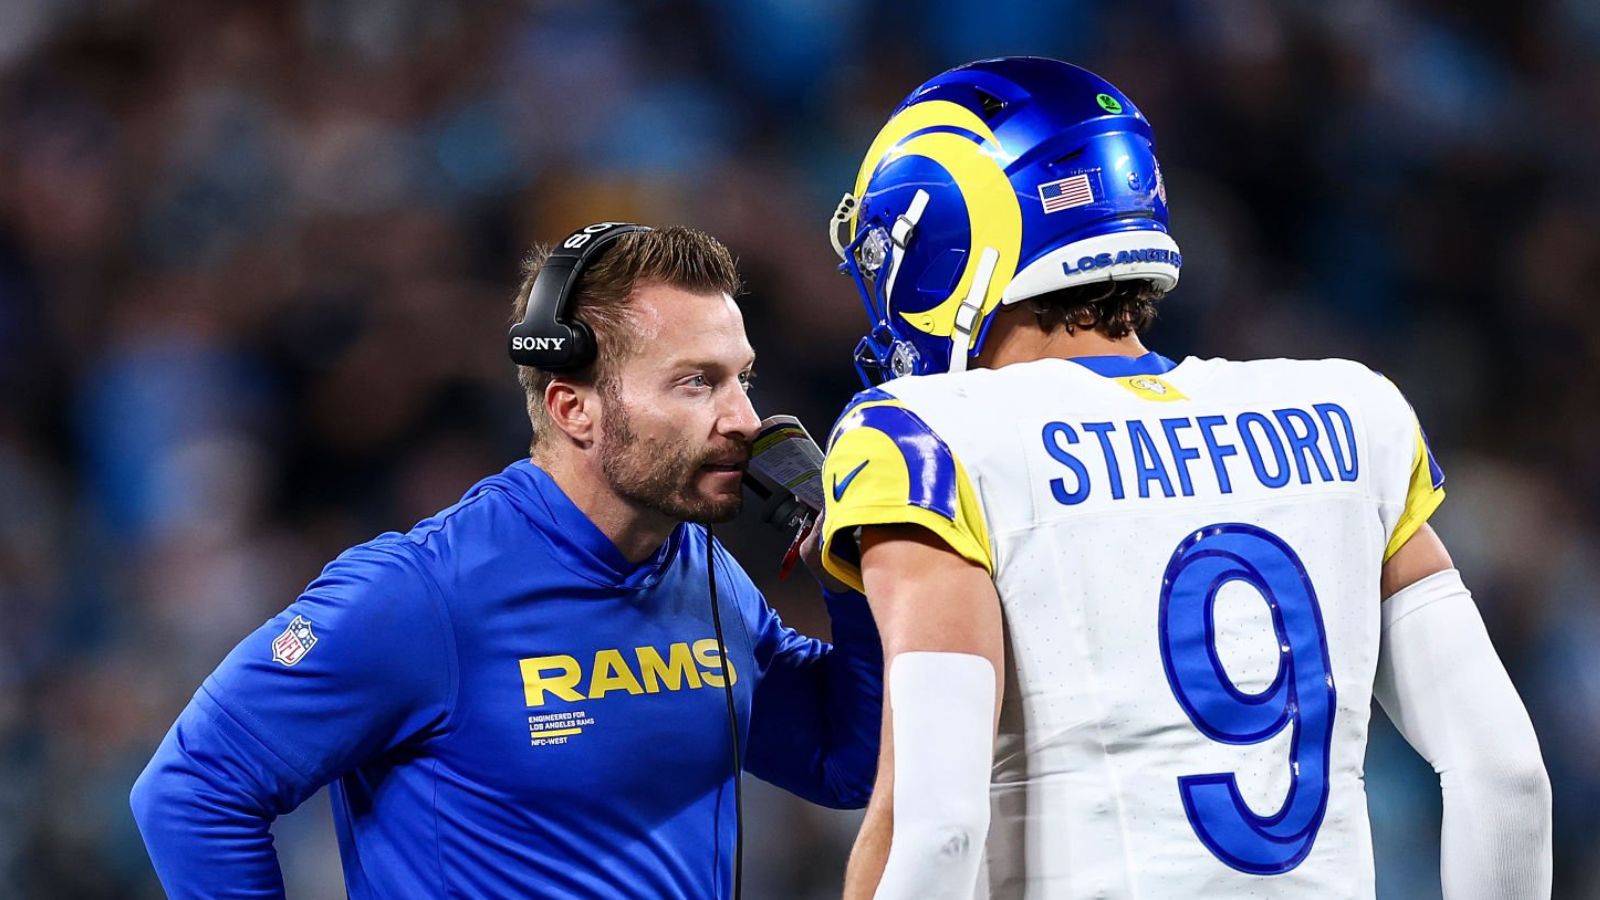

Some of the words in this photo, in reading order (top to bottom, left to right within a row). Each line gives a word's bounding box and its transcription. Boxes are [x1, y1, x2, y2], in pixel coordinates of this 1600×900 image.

[1062, 253, 1113, 276] LOS
[512, 336, 566, 351] SONY
[1041, 402, 1359, 506] STAFFORD
[278, 633, 304, 661] NFL
[519, 638, 738, 707] RAMS
[1158, 522, 1337, 876] 9
[528, 713, 572, 724] ENGINEERED
[572, 711, 586, 719] FOR
[530, 723, 544, 731] LOS
[545, 720, 576, 730] ANGELES
[576, 718, 595, 726] RAMS
[531, 737, 568, 746] NFC-WEST
